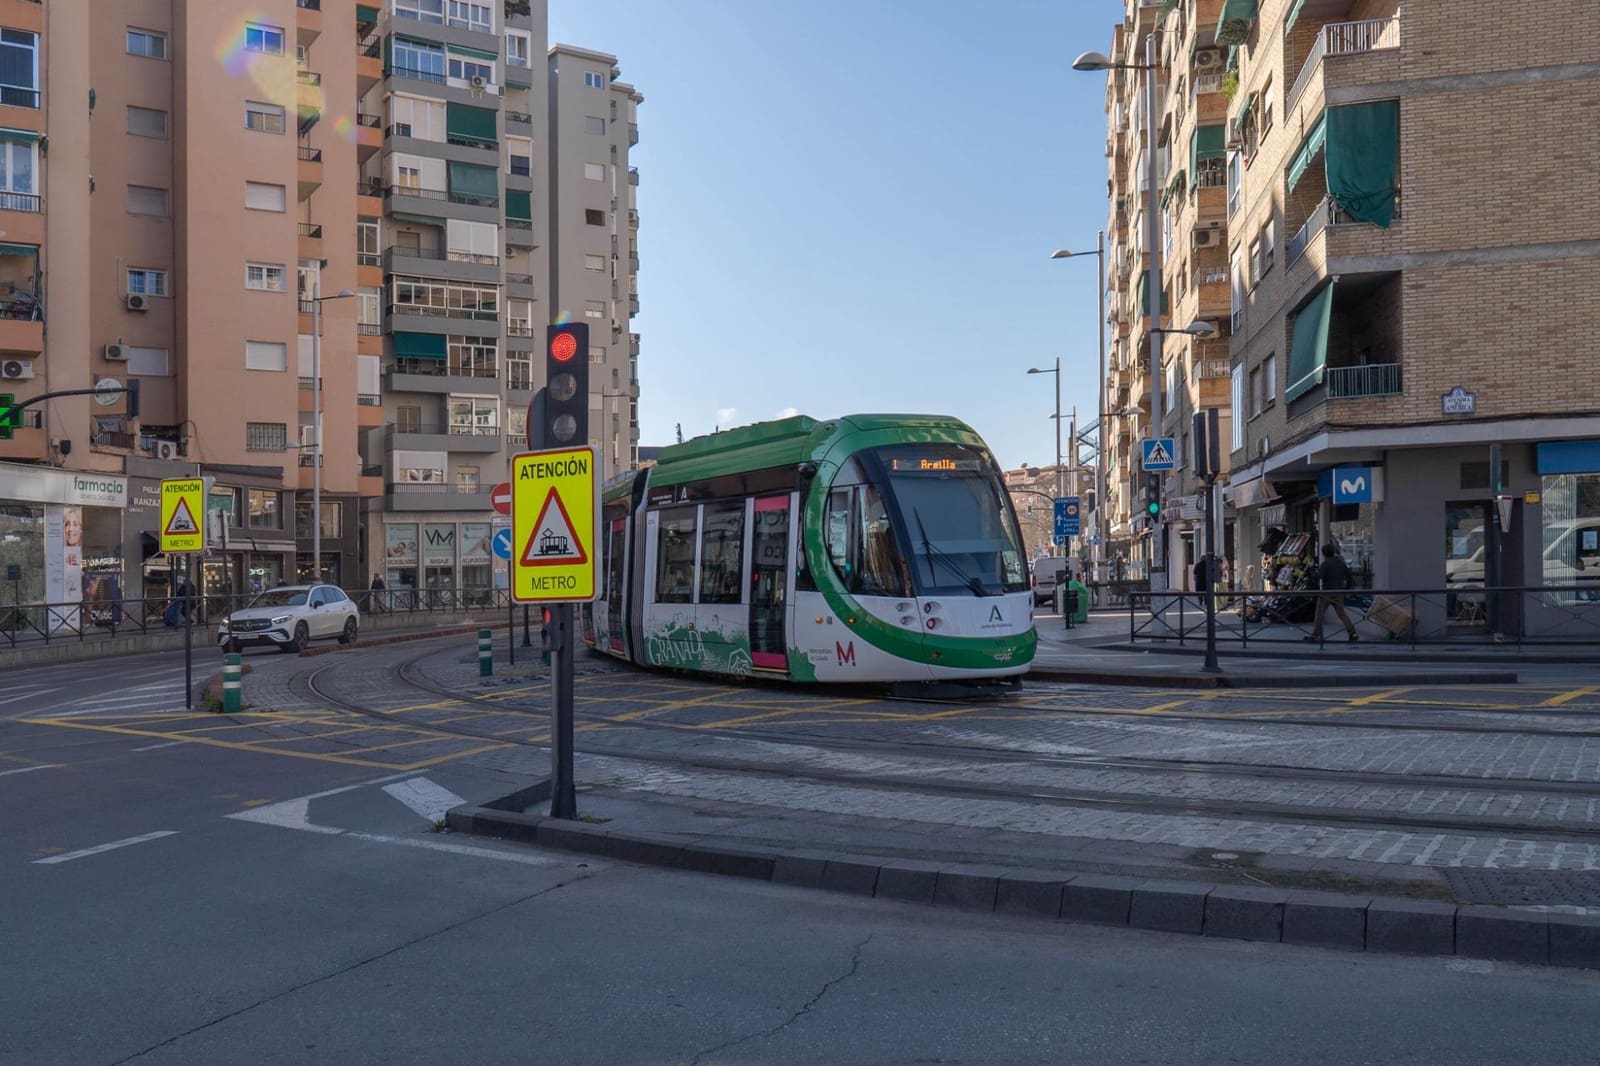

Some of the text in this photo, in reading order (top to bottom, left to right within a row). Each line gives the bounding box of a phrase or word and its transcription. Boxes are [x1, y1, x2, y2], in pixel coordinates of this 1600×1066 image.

[520, 456, 587, 480] ATENCIÓN
[892, 459, 956, 470] 1 Armilla
[73, 476, 123, 494] farmacia
[165, 482, 200, 494] ATENCIÓN
[169, 539, 195, 547] METRO
[531, 575, 577, 591] METRO
[648, 628, 707, 666] GRANADA
